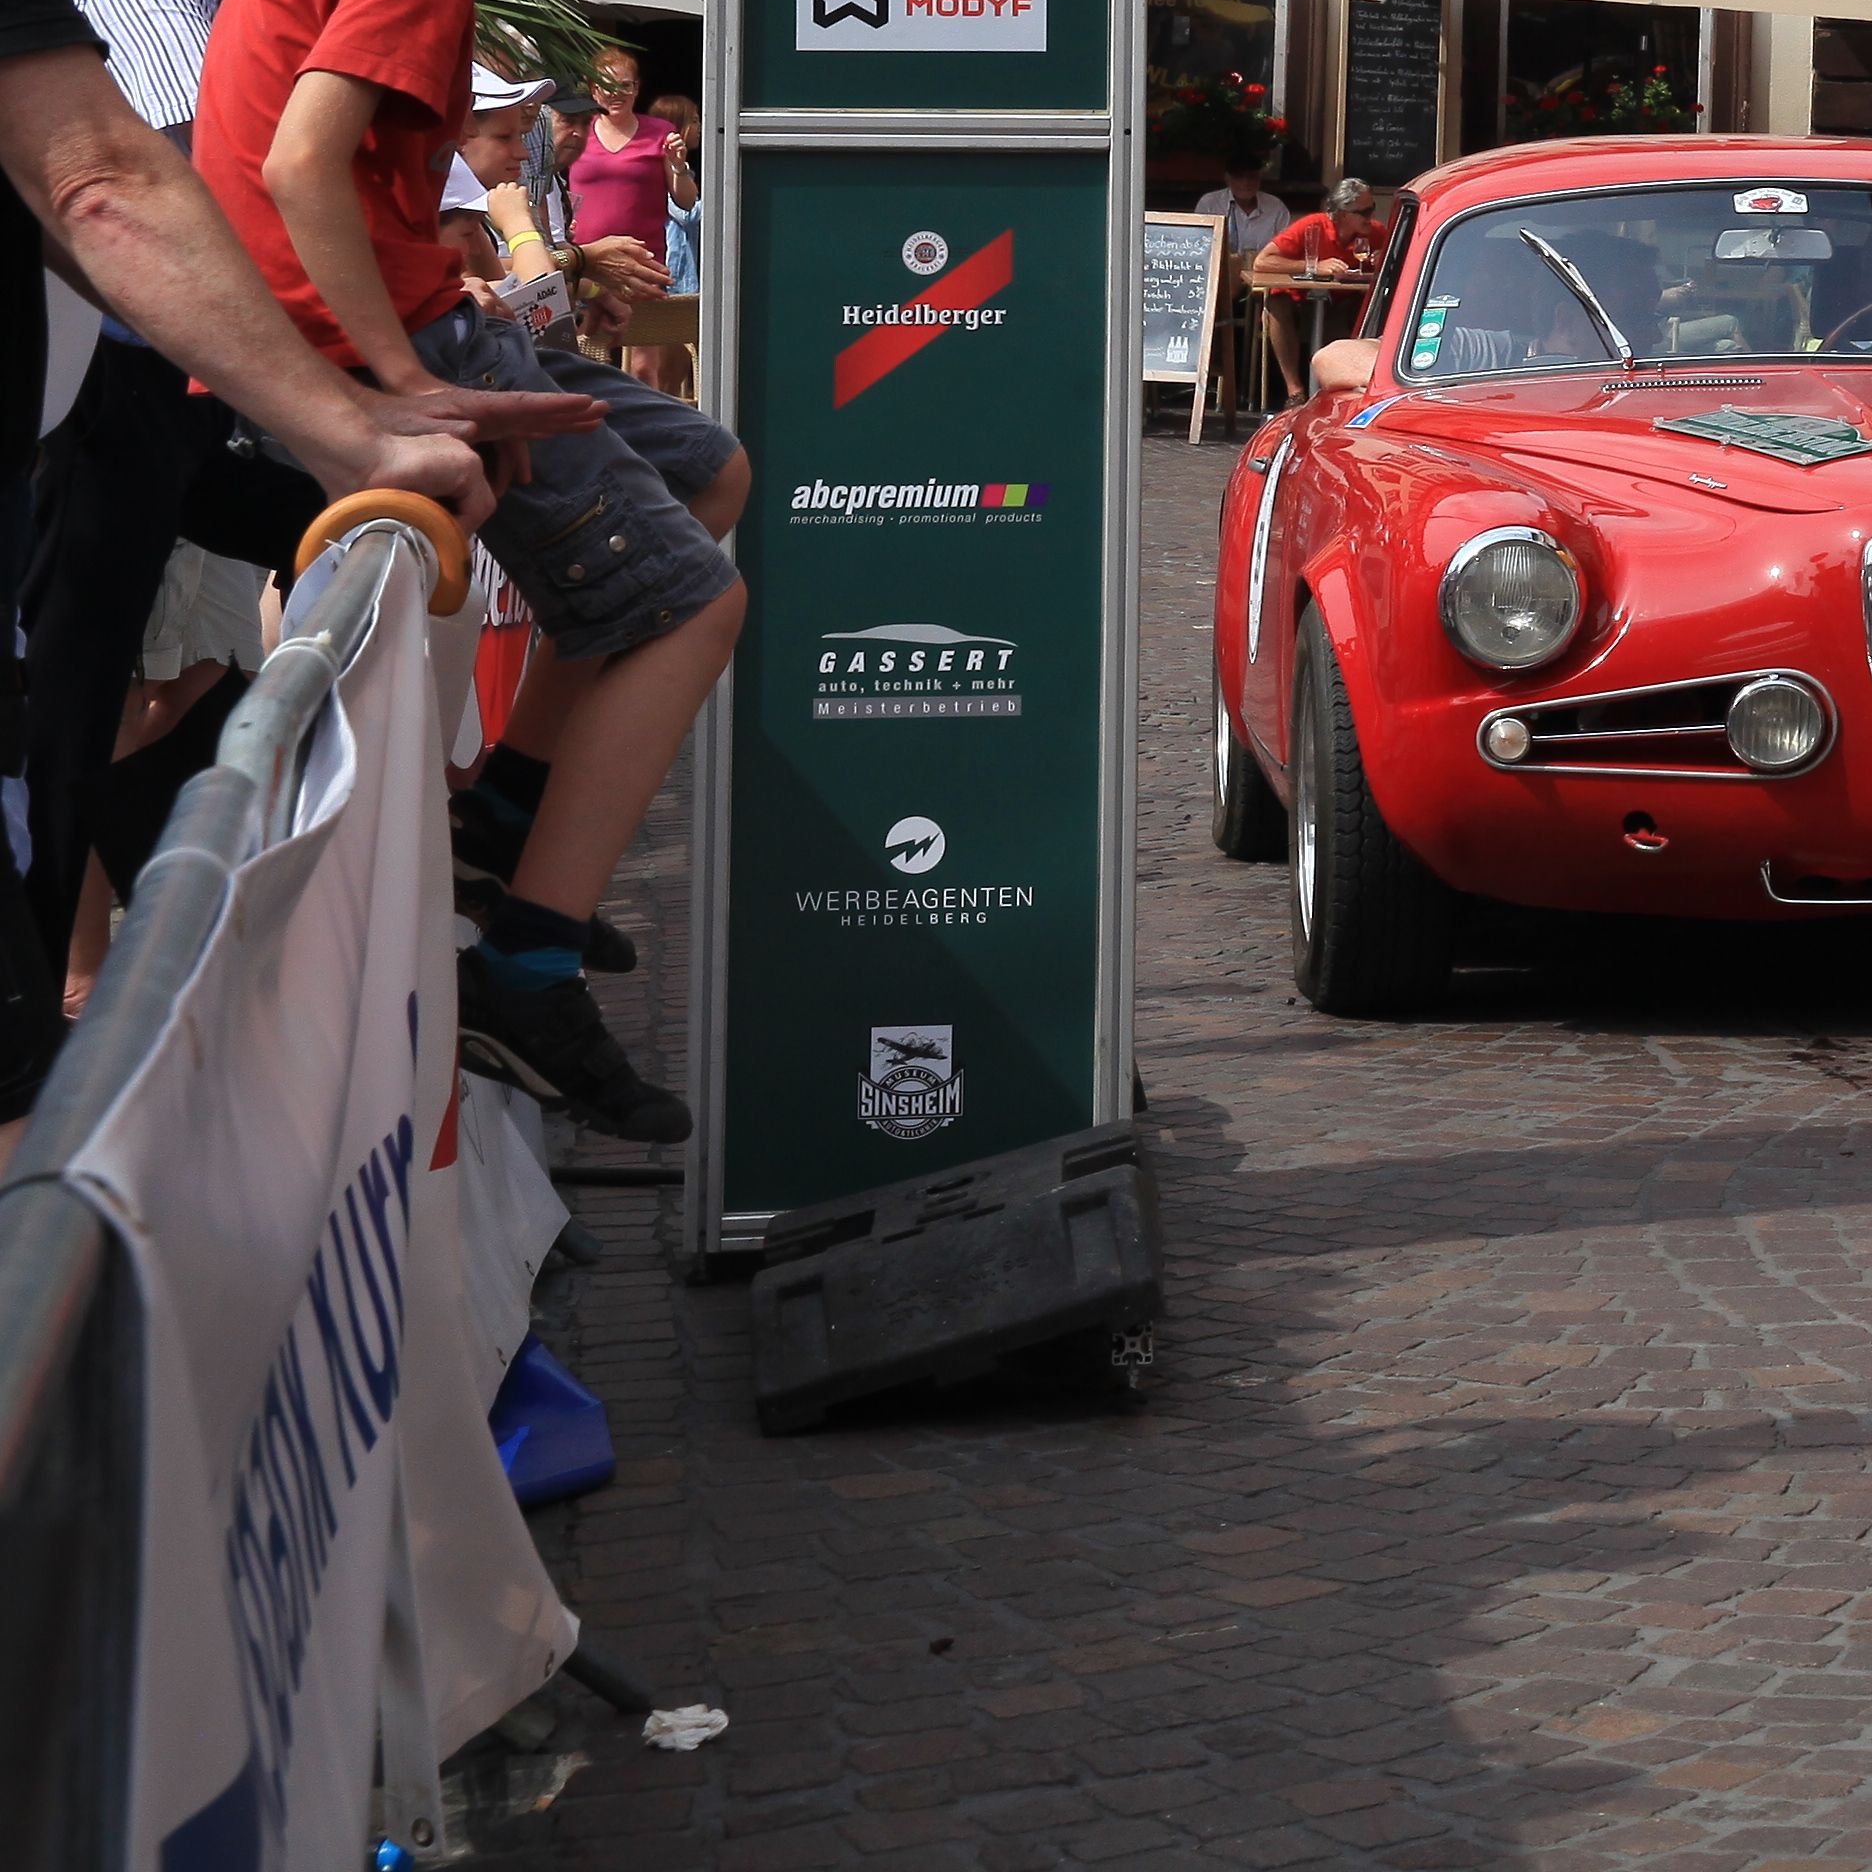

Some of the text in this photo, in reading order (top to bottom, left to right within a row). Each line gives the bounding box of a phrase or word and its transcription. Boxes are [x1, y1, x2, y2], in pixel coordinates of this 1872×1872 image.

[536, 286, 558, 301] ADAC
[842, 304, 1007, 331] Heidelberger
[791, 478, 980, 515] abcpremium
[789, 512, 1043, 526] merchandising promotional products
[818, 649, 1013, 674] GASSERT
[818, 679, 865, 694] auto,
[874, 678, 943, 692] technik
[971, 678, 1016, 691] mehr
[818, 699, 1016, 715] Meisterbetrieb
[796, 886, 1034, 912] WERBEAGENTEN
[841, 912, 988, 926] HEIDELBERG
[886, 1068, 937, 1088] MUSEUM
[860, 1076, 962, 1117] SINSHEIM
